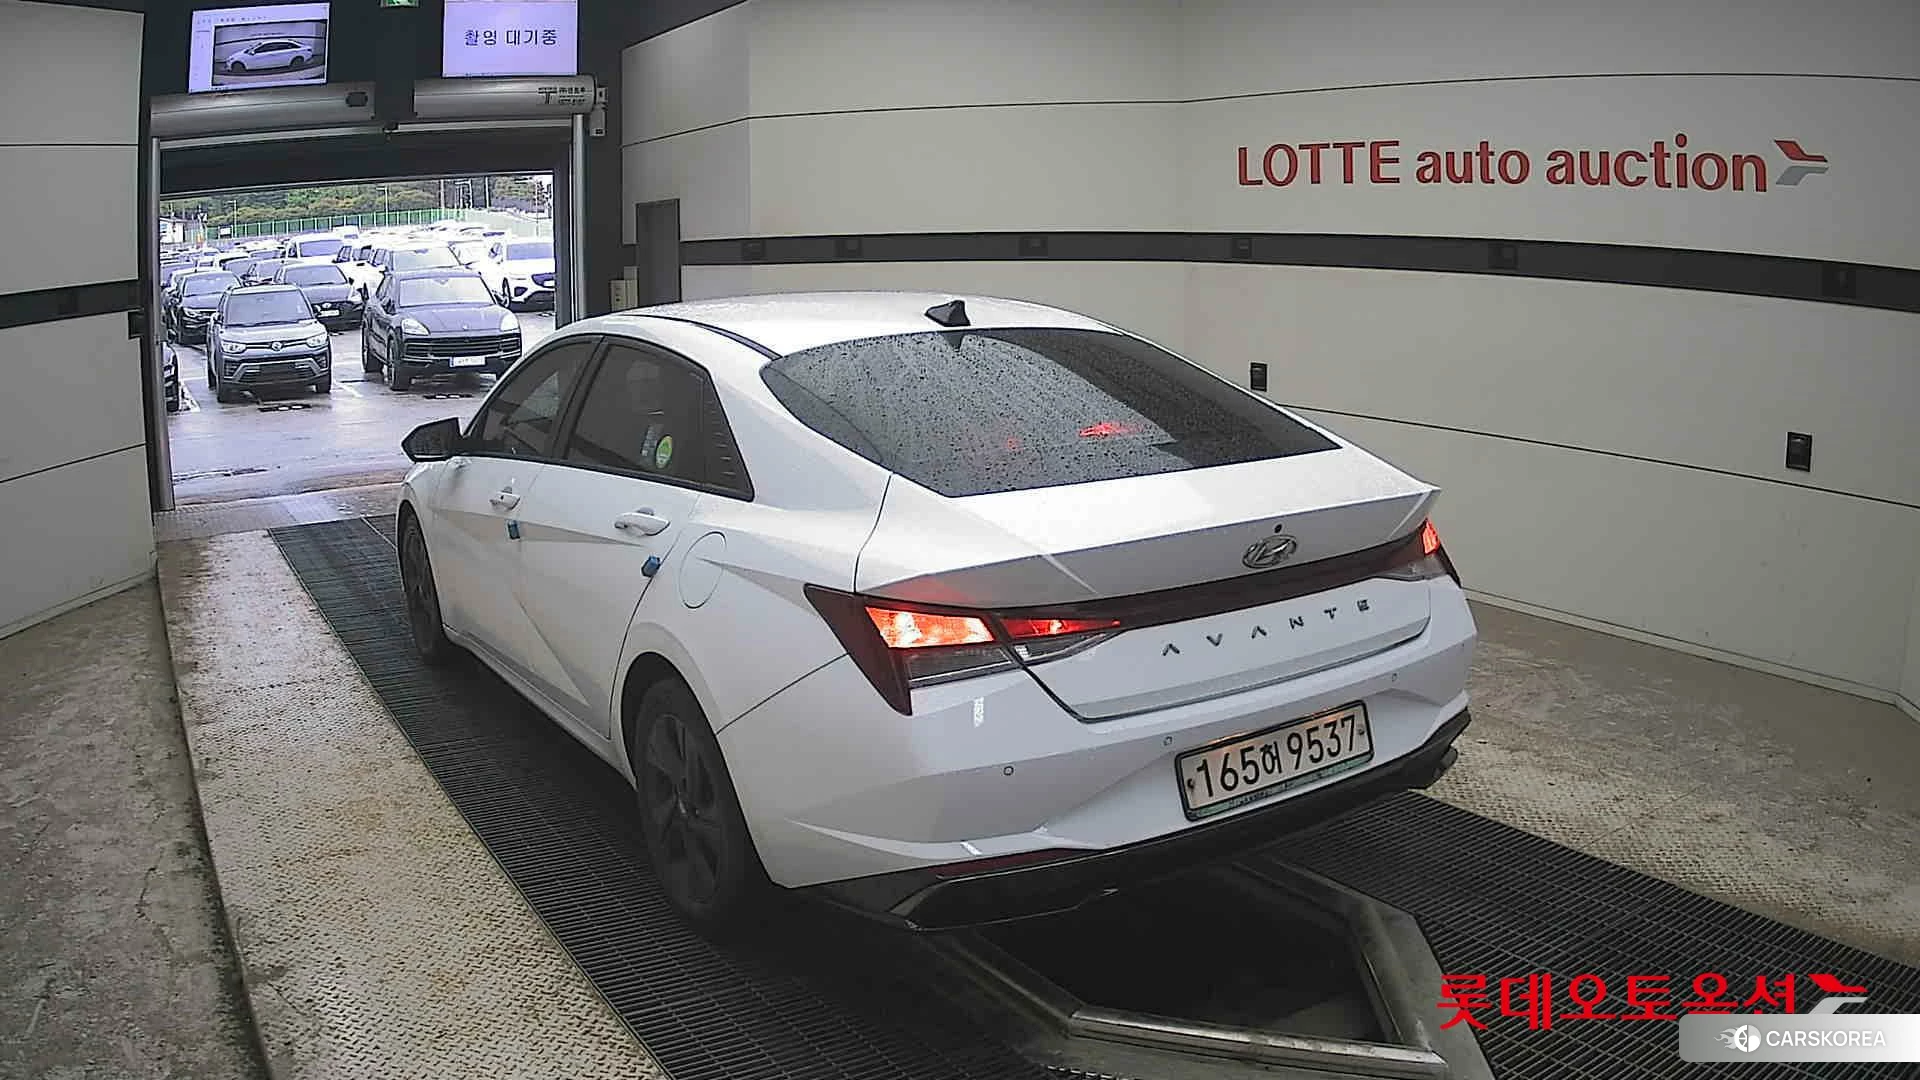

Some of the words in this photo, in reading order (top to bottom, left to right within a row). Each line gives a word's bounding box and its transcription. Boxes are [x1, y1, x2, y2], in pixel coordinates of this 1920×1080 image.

[505, 29, 558, 46] 대기중
[1237, 140, 1400, 186] LOTTE
[1415, 141, 1530, 185] auto
[1545, 133, 1767, 192] auction
[1161, 599, 1370, 657] AVANTE
[1286, 714, 1357, 771] 9537
